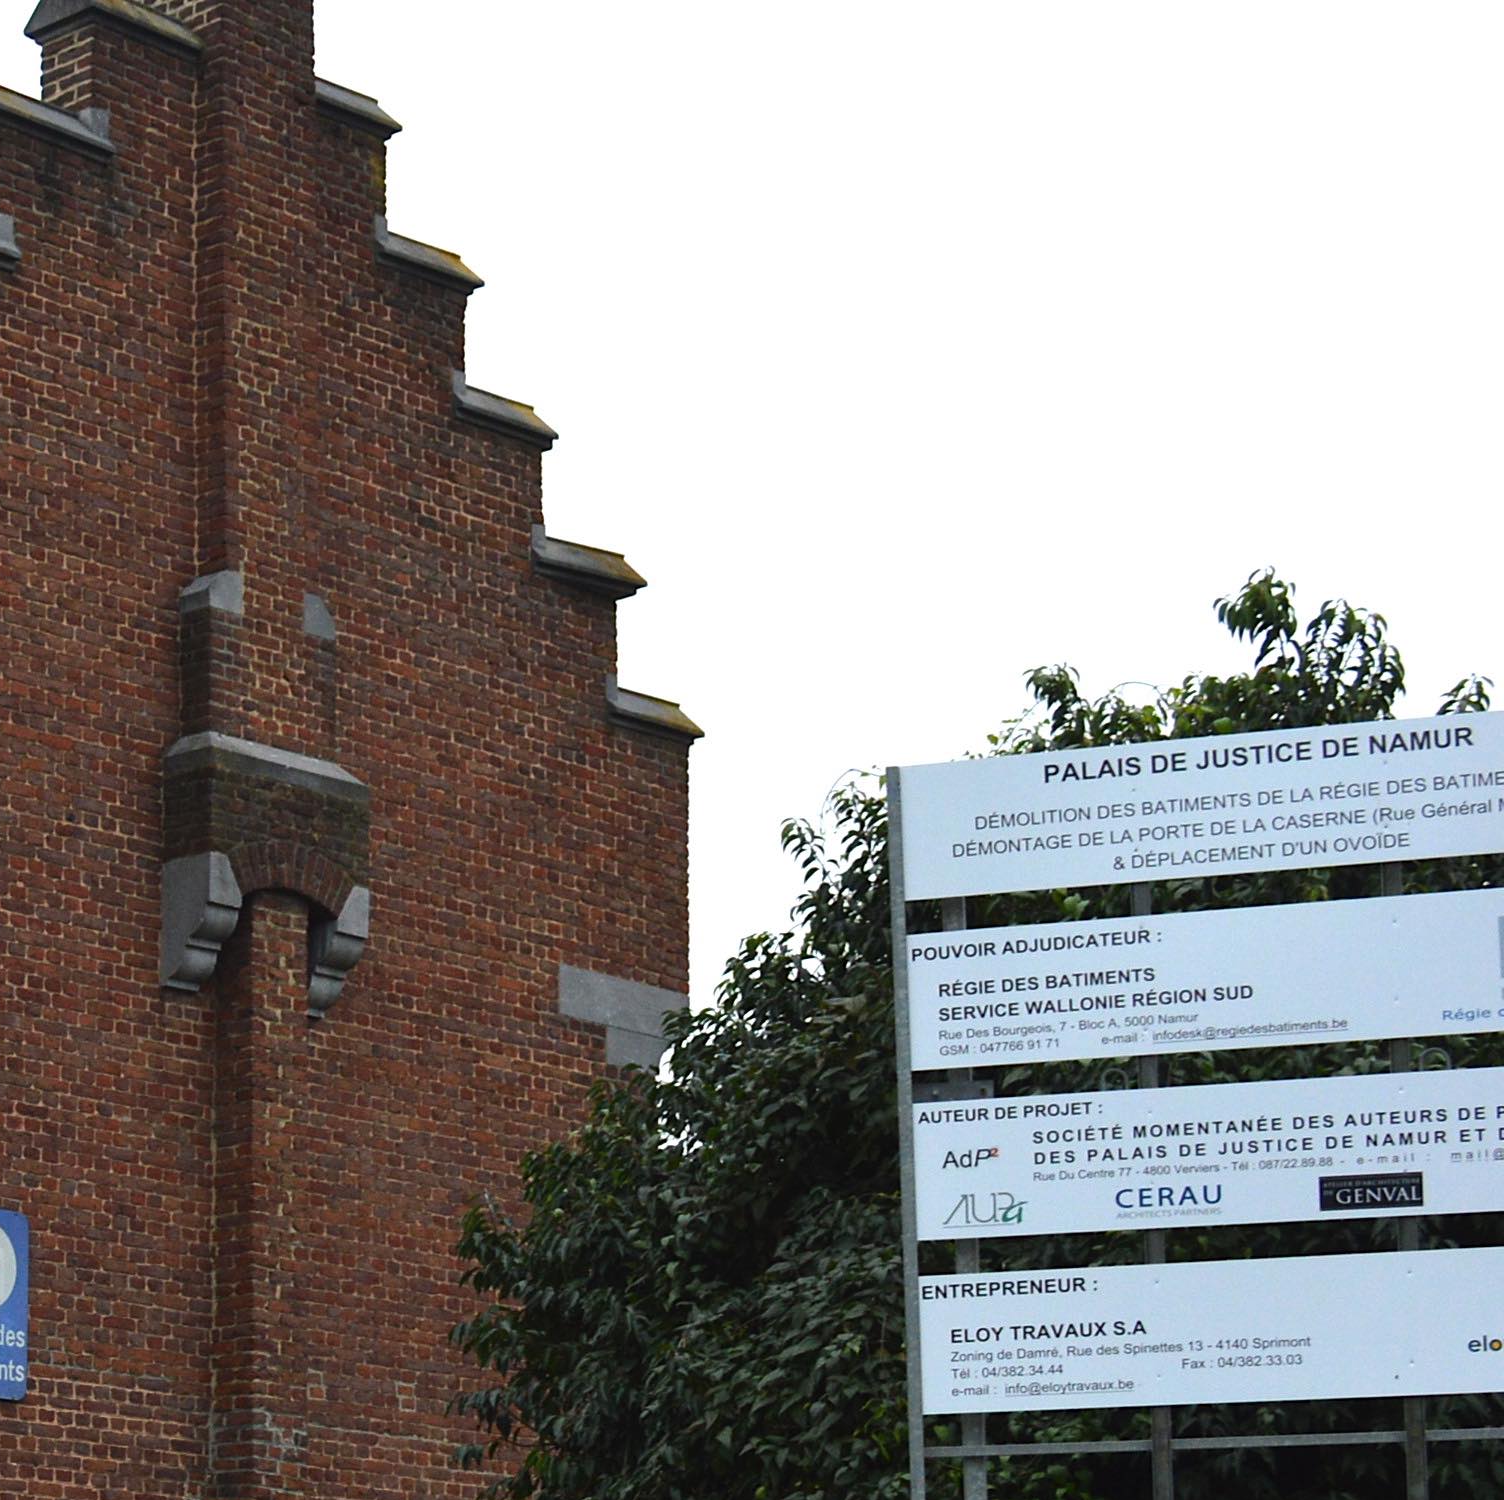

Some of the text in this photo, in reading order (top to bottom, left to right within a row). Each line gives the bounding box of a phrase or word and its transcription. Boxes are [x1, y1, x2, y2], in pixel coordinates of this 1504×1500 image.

[1044, 727, 1473, 783] PALAIS DE JUSTICE DE NAMUR
[975, 807, 1091, 830] DÉMOLITION
[1097, 802, 1135, 819] DES
[1142, 793, 1251, 815] BATIMENTS
[1258, 790, 1284, 806] DE
[1290, 788, 1314, 803] LA
[1320, 782, 1380, 800] RÉGIE
[1387, 777, 1427, 795] DES
[952, 834, 1072, 858] DÉMONTAGE
[1079, 832, 1104, 846] DE
[1110, 830, 1133, 844] LA
[1139, 823, 1204, 842] PORTE
[1211, 820, 1236, 836] DE
[1243, 818, 1266, 833] LA
[1272, 809, 1366, 831] CASERNE
[1373, 807, 1415, 827] (Rue
[1421, 799, 1492, 818] Général
[1113, 832, 1410, 870] & DÉPLACEMENT D'UN OVOÏDE
[912, 930, 1150, 962] POUVOIR ADJUDICATEUR
[939, 968, 1155, 997] RÉGIE DES BATIMENTS
[939, 985, 1253, 1022] SERVICE WALLONIE RÉGION SUD
[1442, 1009, 1491, 1021] Régie
[939, 1030, 962, 1040] Rue
[966, 1028, 989, 1038] Des
[993, 1025, 1055, 1037] Bourgeois,
[1060, 1021, 1067, 1031] 7
[1079, 1019, 1105, 1030] Bloc
[1125, 1015, 1154, 1027] 5000
[1158, 1014, 1199, 1024] Namur
[1101, 1019, 1348, 1045] e-mail infodesk@regiedesbatiments.be
[940, 1044, 969, 1056] GSM
[1027, 1039, 1040, 1049] 91
[1046, 1038, 1059, 1048] 71
[918, 1101, 1092, 1124] AUTEUR DE PROJET
[1033, 1107, 1486, 1144] SOCIÉTÉ MOMENTANÉE DES AUTEURS DE
[1034, 1128, 1486, 1164] DES PALAIS DE JUSTICE DE NAMUR ET
[1033, 1172, 1055, 1181] Rue
[1059, 1170, 1075, 1181] Du
[1078, 1169, 1115, 1180] Centre
[1118, 1167, 1132, 1177] 77
[1143, 1165, 1171, 1176] 4800
[1174, 1165, 1220, 1174] Verviers
[1231, 1161, 1249, 1171] Tél
[1116, 1185, 1221, 1208] CERAU
[1336, 1186, 1421, 1204] GENVAL
[922, 1277, 1086, 1300] ENTREPRENEUR
[951, 1320, 1147, 1343] ELOY TRAVAUX S.A
[951, 1351, 993, 1363] Zoning
[997, 1350, 1012, 1360] de
[1067, 1346, 1092, 1356] Rue
[1096, 1344, 1120, 1356] des
[1123, 1343, 1184, 1356] Spinettes
[1189, 1340, 1203, 1351] 13
[1216, 1338, 1248, 1349] 4140
[1252, 1337, 1311, 1351] Sprimont
[1182, 1354, 1303, 1369] Fax 04/382.33.03
[951, 1364, 1063, 1379] Tél 04/382.34.44
[952, 1379, 1134, 1397] e-mail info@eloytravaux.be
